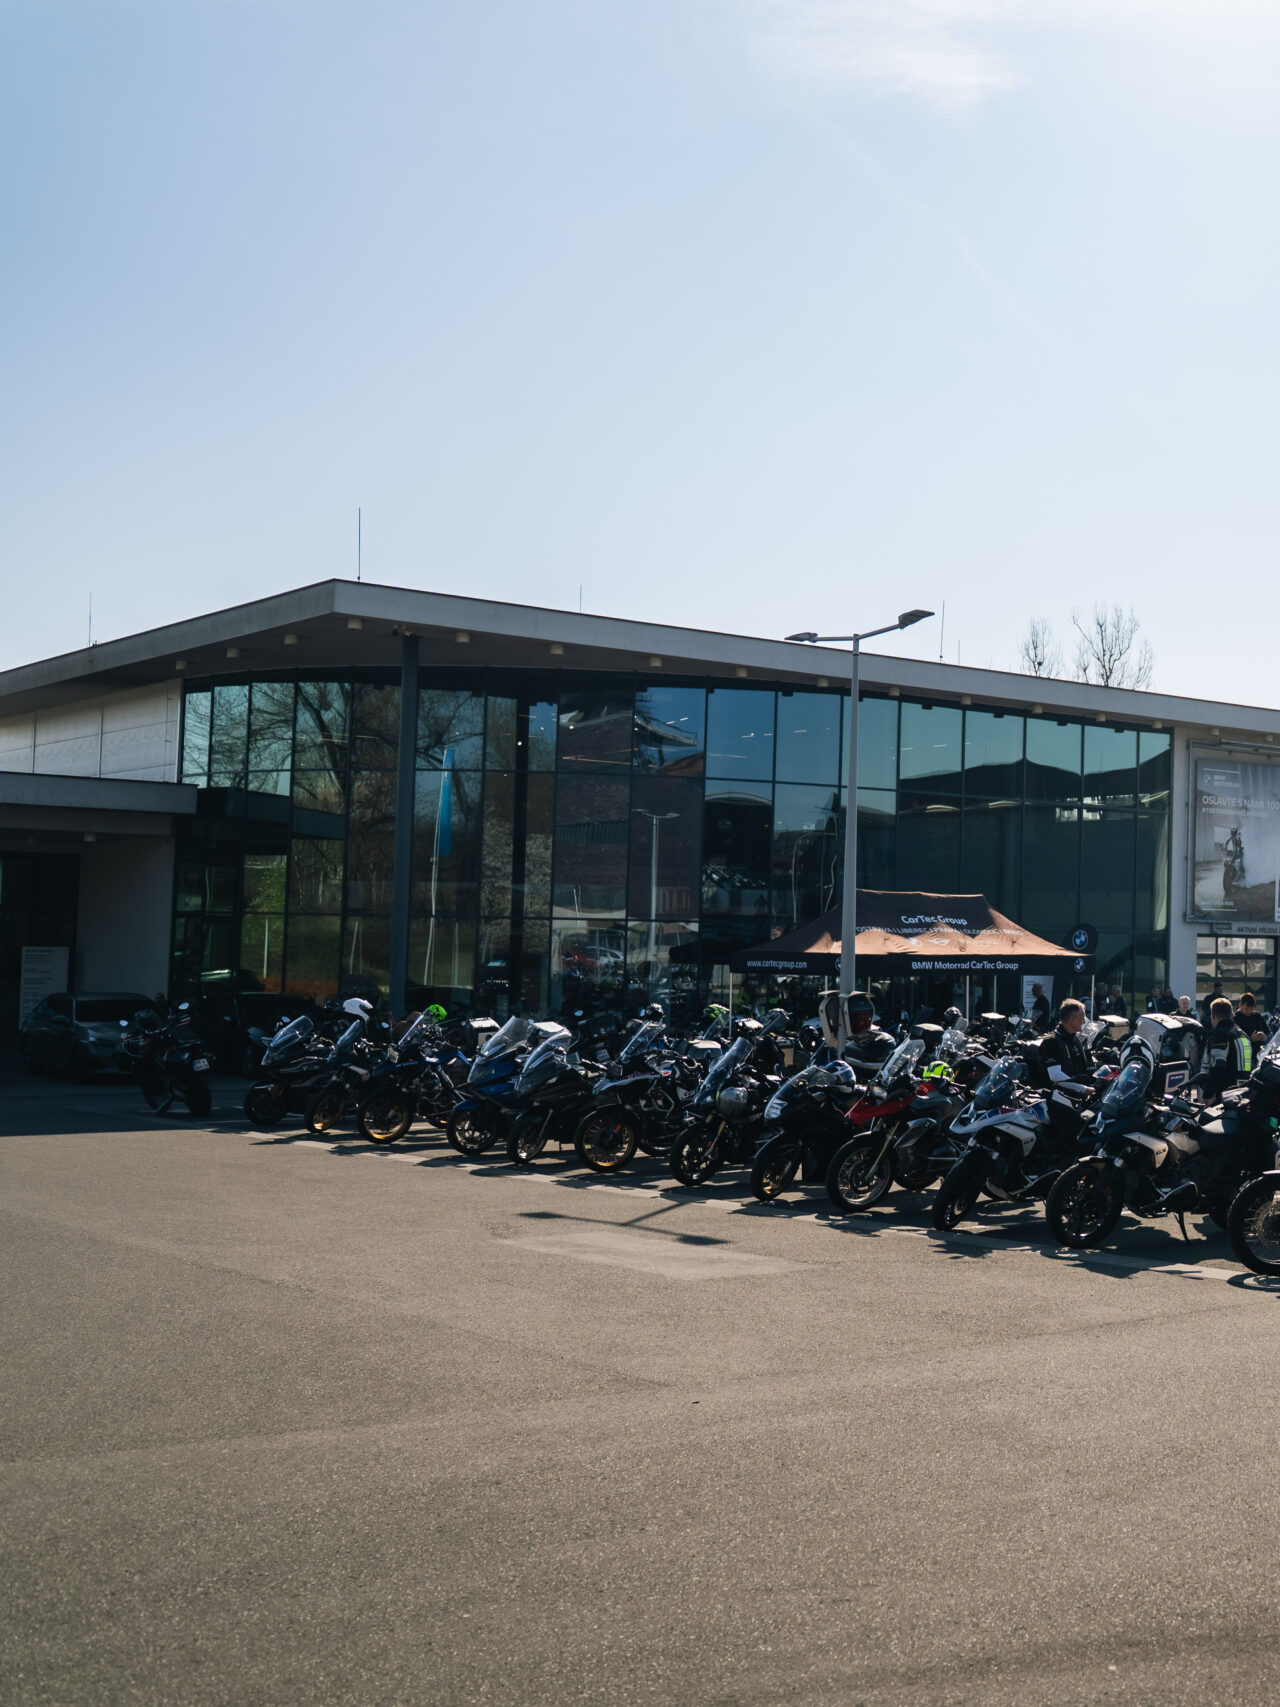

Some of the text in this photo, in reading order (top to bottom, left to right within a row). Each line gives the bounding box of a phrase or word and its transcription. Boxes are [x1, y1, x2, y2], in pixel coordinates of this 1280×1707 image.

[1202, 796, 1237, 807] OSLAVTE
[901, 915, 968, 926] CarTec Group
[856, 926, 892, 934] OSTRAVA
[747, 959, 807, 969] www.cartecgroup.com
[911, 960, 1019, 971] BMW Motorrad CarTec Group
